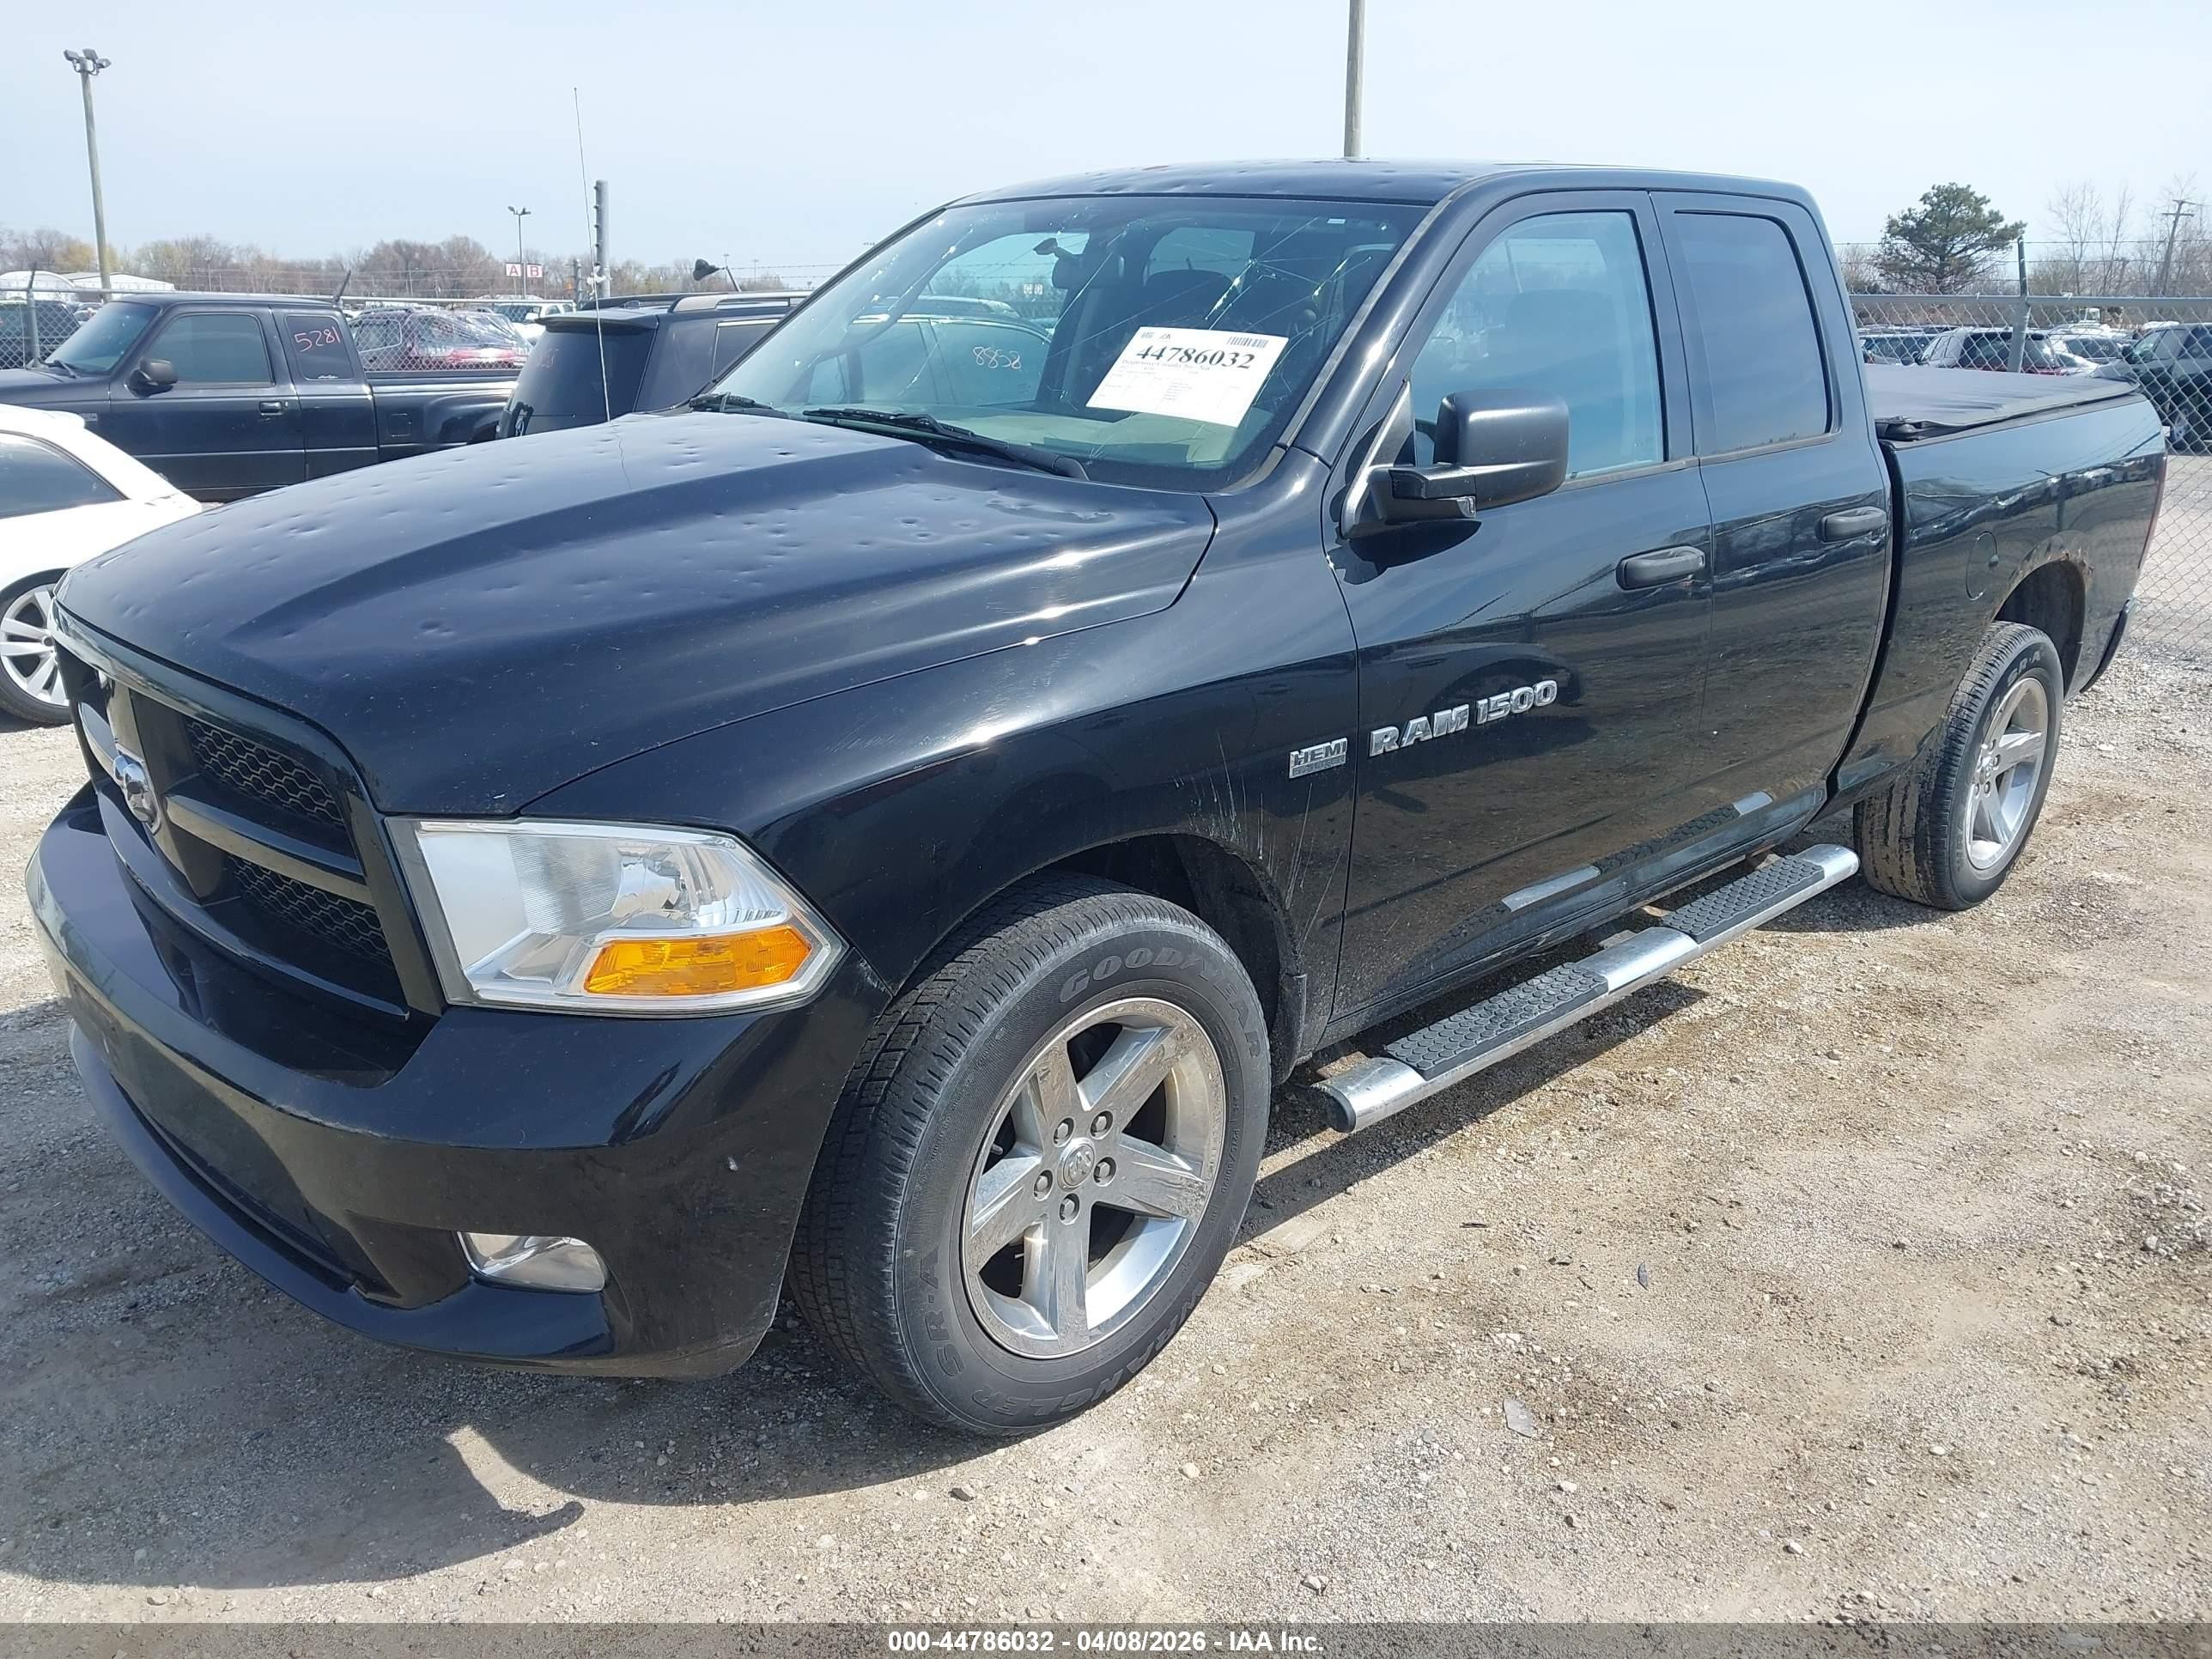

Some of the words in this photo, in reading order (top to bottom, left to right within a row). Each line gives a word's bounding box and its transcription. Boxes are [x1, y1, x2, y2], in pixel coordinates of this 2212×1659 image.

[509, 264, 519, 276] A
[530, 265, 539, 276] B
[293, 325, 341, 353] 5281
[1136, 344, 1255, 369] 44786032
[1369, 704, 1470, 757] RAM
[1475, 680, 1559, 725] 1500
[1290, 738, 1348, 768] HEMI
[1059, 947, 1261, 1059] GOODYEAR
